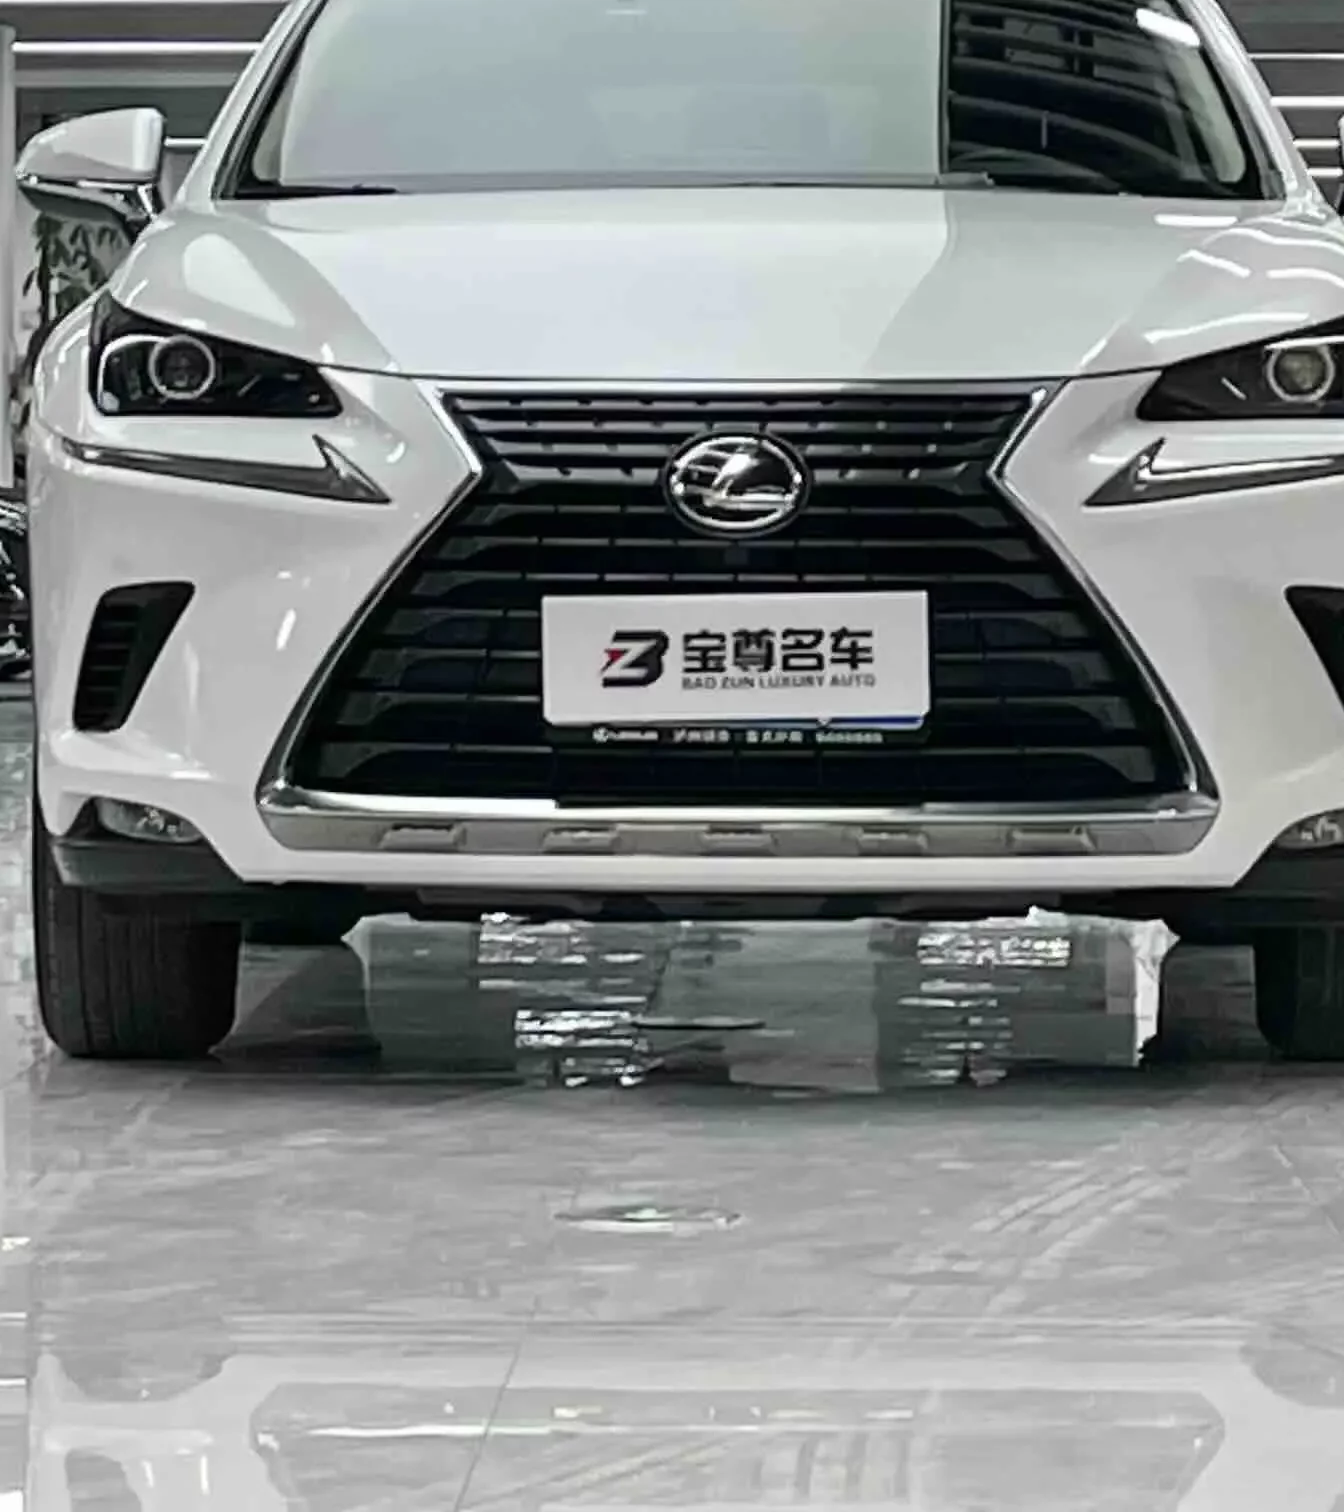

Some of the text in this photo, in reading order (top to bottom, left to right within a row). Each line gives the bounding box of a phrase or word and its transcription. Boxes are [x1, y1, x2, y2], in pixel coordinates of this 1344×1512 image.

[682, 626, 874, 673] 宝尊名车
[722, 676, 755, 688] ZUN
[759, 675, 825, 688] LUXURY
[829, 674, 876, 688] AUTO
